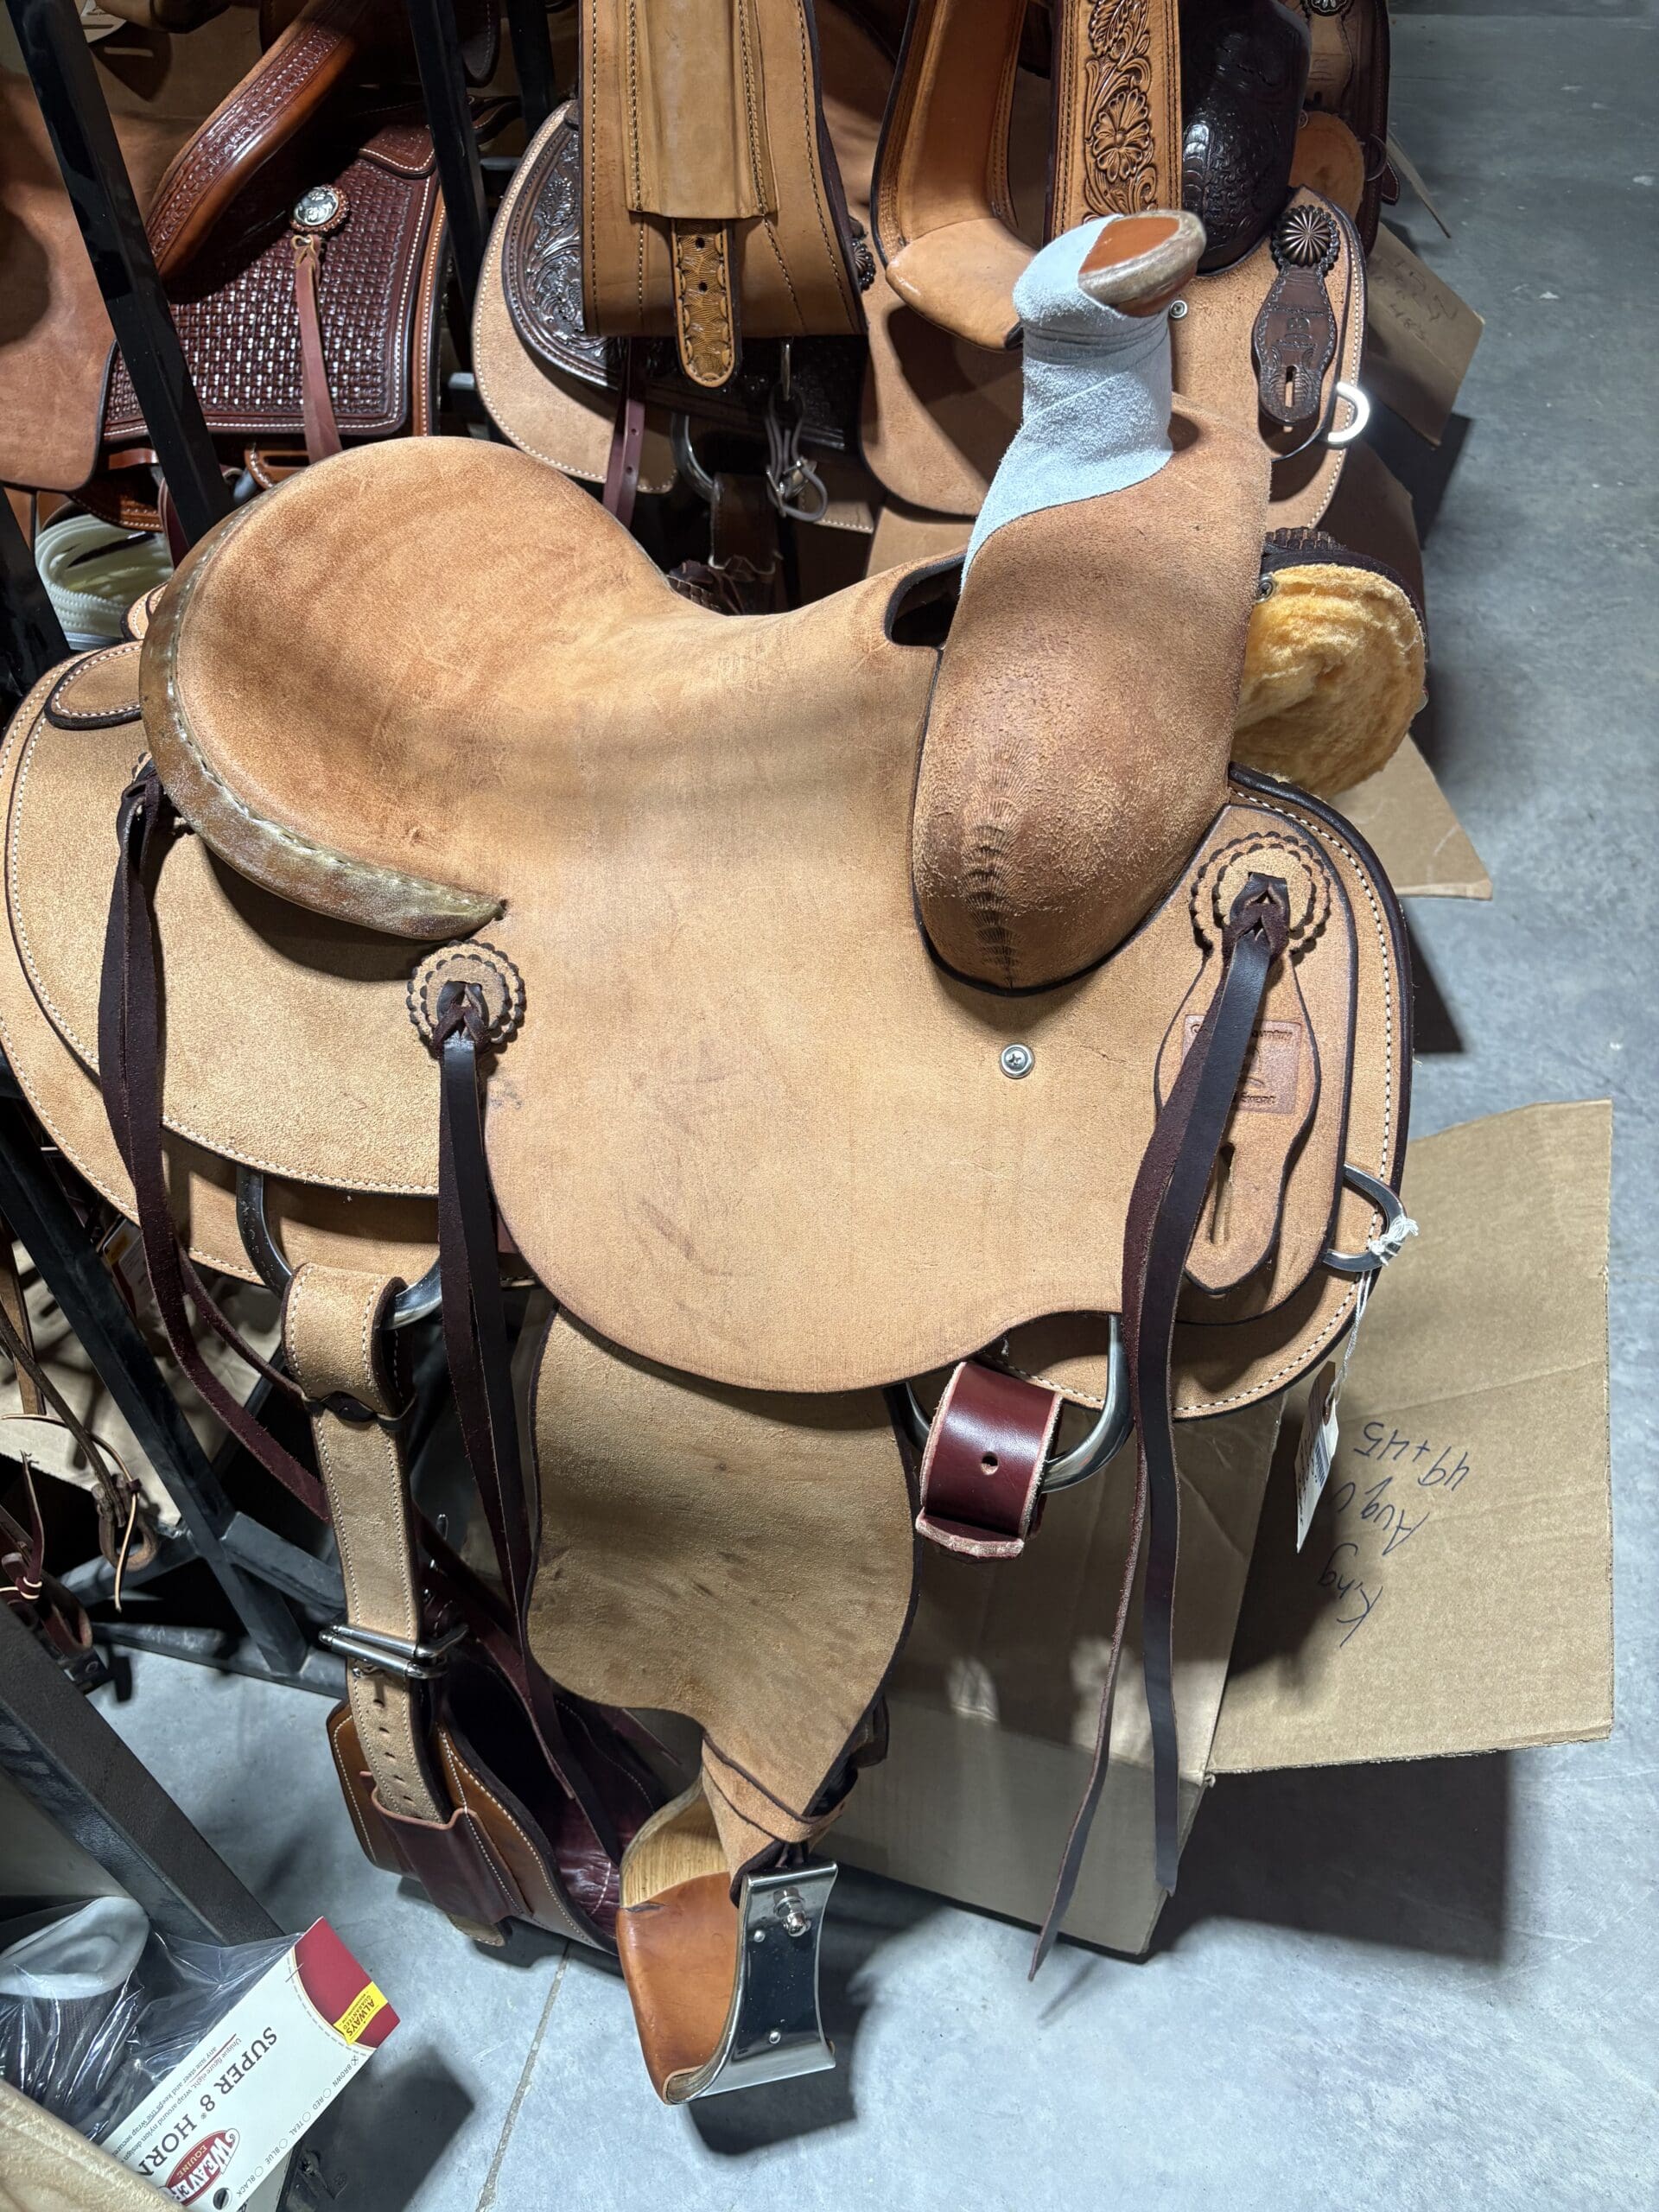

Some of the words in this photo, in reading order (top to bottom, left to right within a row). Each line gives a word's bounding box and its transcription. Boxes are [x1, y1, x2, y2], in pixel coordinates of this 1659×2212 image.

[1361, 1477, 1431, 1556] Aug
[342, 1994, 371, 2030] GUARANTEED
[345, 1998, 374, 2037] ALWAYS
[221, 2038, 241, 2057] Unique
[207, 2057, 222, 2074] figure
[213, 2027, 276, 2094] SUPER
[183, 2069, 196, 2083] steer
[333, 2064, 352, 2087] BROWN
[171, 2082, 183, 2095] and
[177, 2089, 192, 2104] wrap
[156, 2094, 173, 2112] keeps
[313, 2096, 324, 2109] RED
[157, 2103, 177, 2126] around
[132, 2120, 147, 2136] wrap
[141, 2124, 158, 2141] nylon
[289, 2120, 304, 2135] TEAL
[122, 2141, 142, 2162] design
[175, 2145, 207, 2177] EQUINE
[265, 2147, 280, 2164] BLUE
[168, 2128, 240, 2202] WEAVER
[237, 2175, 256, 2197] BLACK
